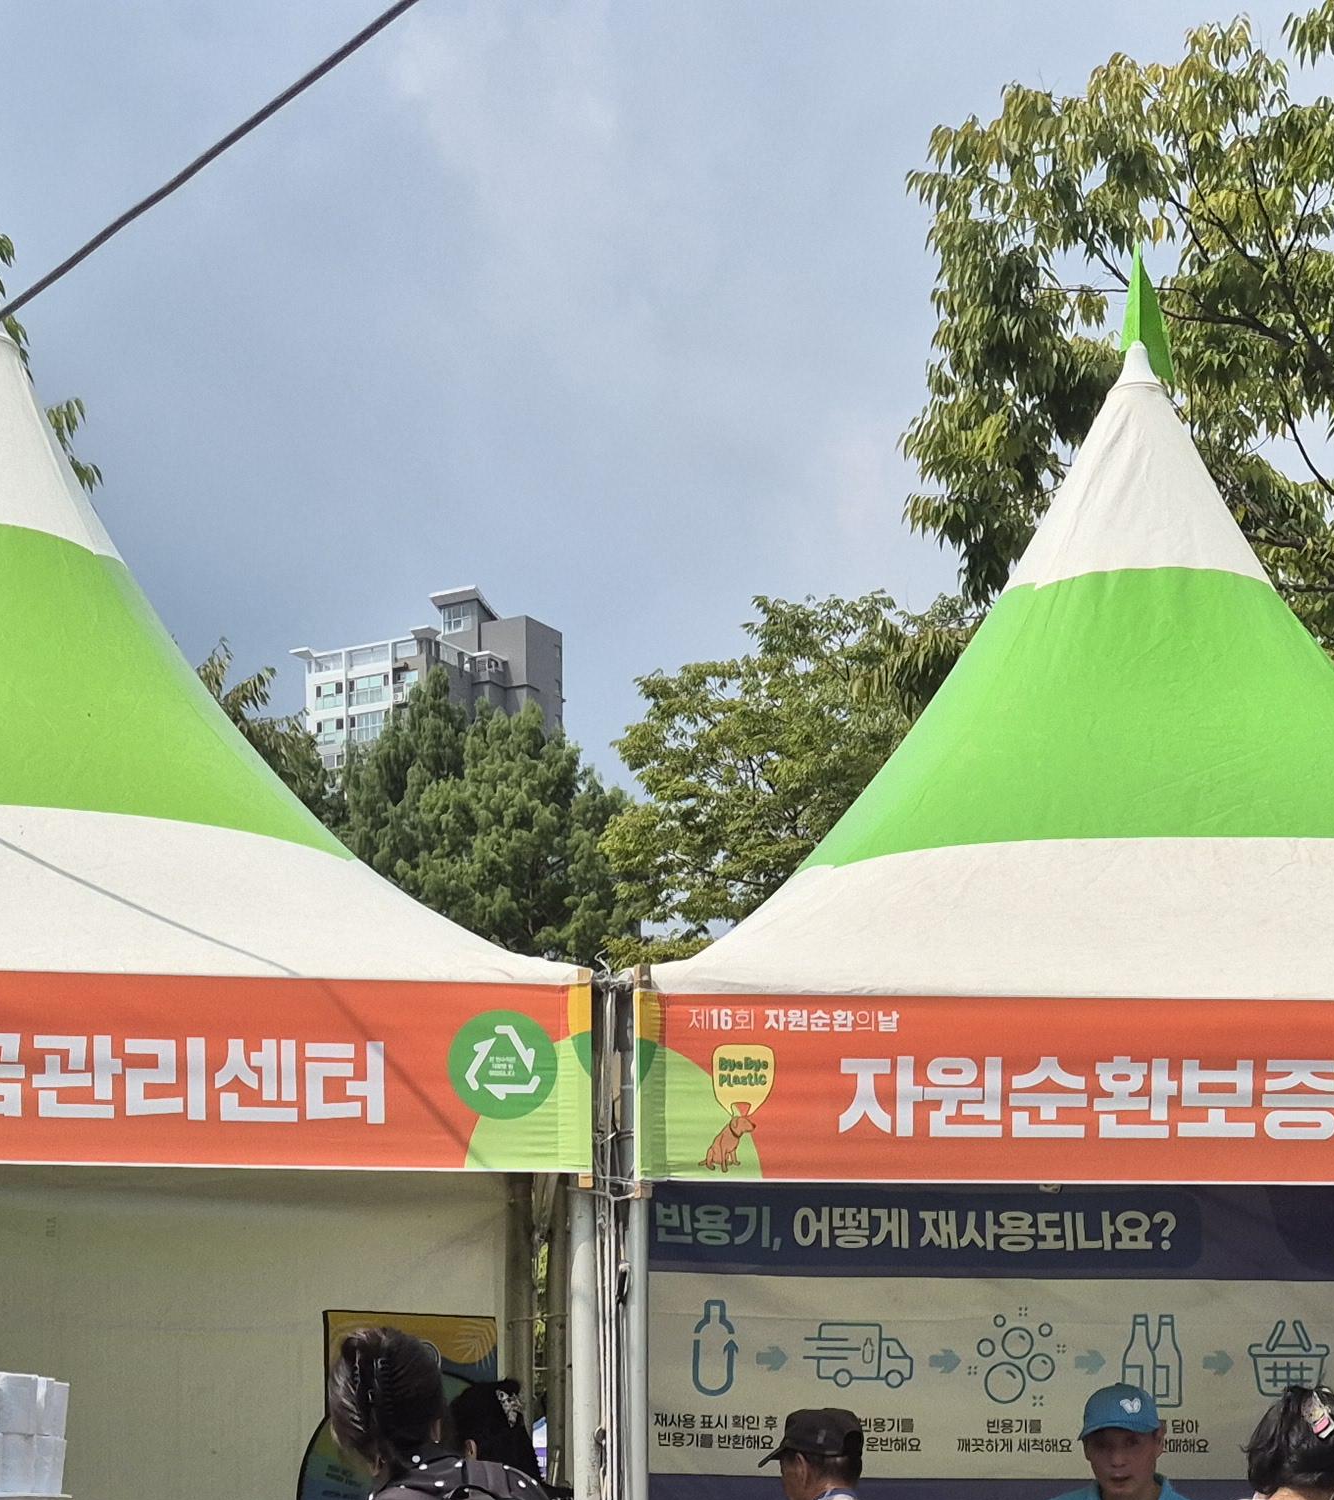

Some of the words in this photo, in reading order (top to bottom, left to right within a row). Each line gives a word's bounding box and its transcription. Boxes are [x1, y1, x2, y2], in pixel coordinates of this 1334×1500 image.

[689, 1009, 755, 1031] 제16회
[656, 1203, 782, 1251] 빈용기,
[793, 1207, 909, 1249] 어떻게
[919, 1209, 1177, 1252] 재사용되나요?
[654, 1413, 695, 1429] 재사용
[700, 1414, 727, 1429] 표시
[732, 1415, 759, 1430] 확인
[764, 1416, 778, 1430] 후
[986, 1419, 1041, 1433] 빈용기를
[1171, 1420, 1198, 1433] 담아
[658, 1433, 713, 1448] 빈용기를
[718, 1434, 774, 1450] 반환해요
[865, 1436, 921, 1452] 운반해요
[957, 1438, 1013, 1453] 깨끗하게
[1017, 1439, 1072, 1453] 세척해요
